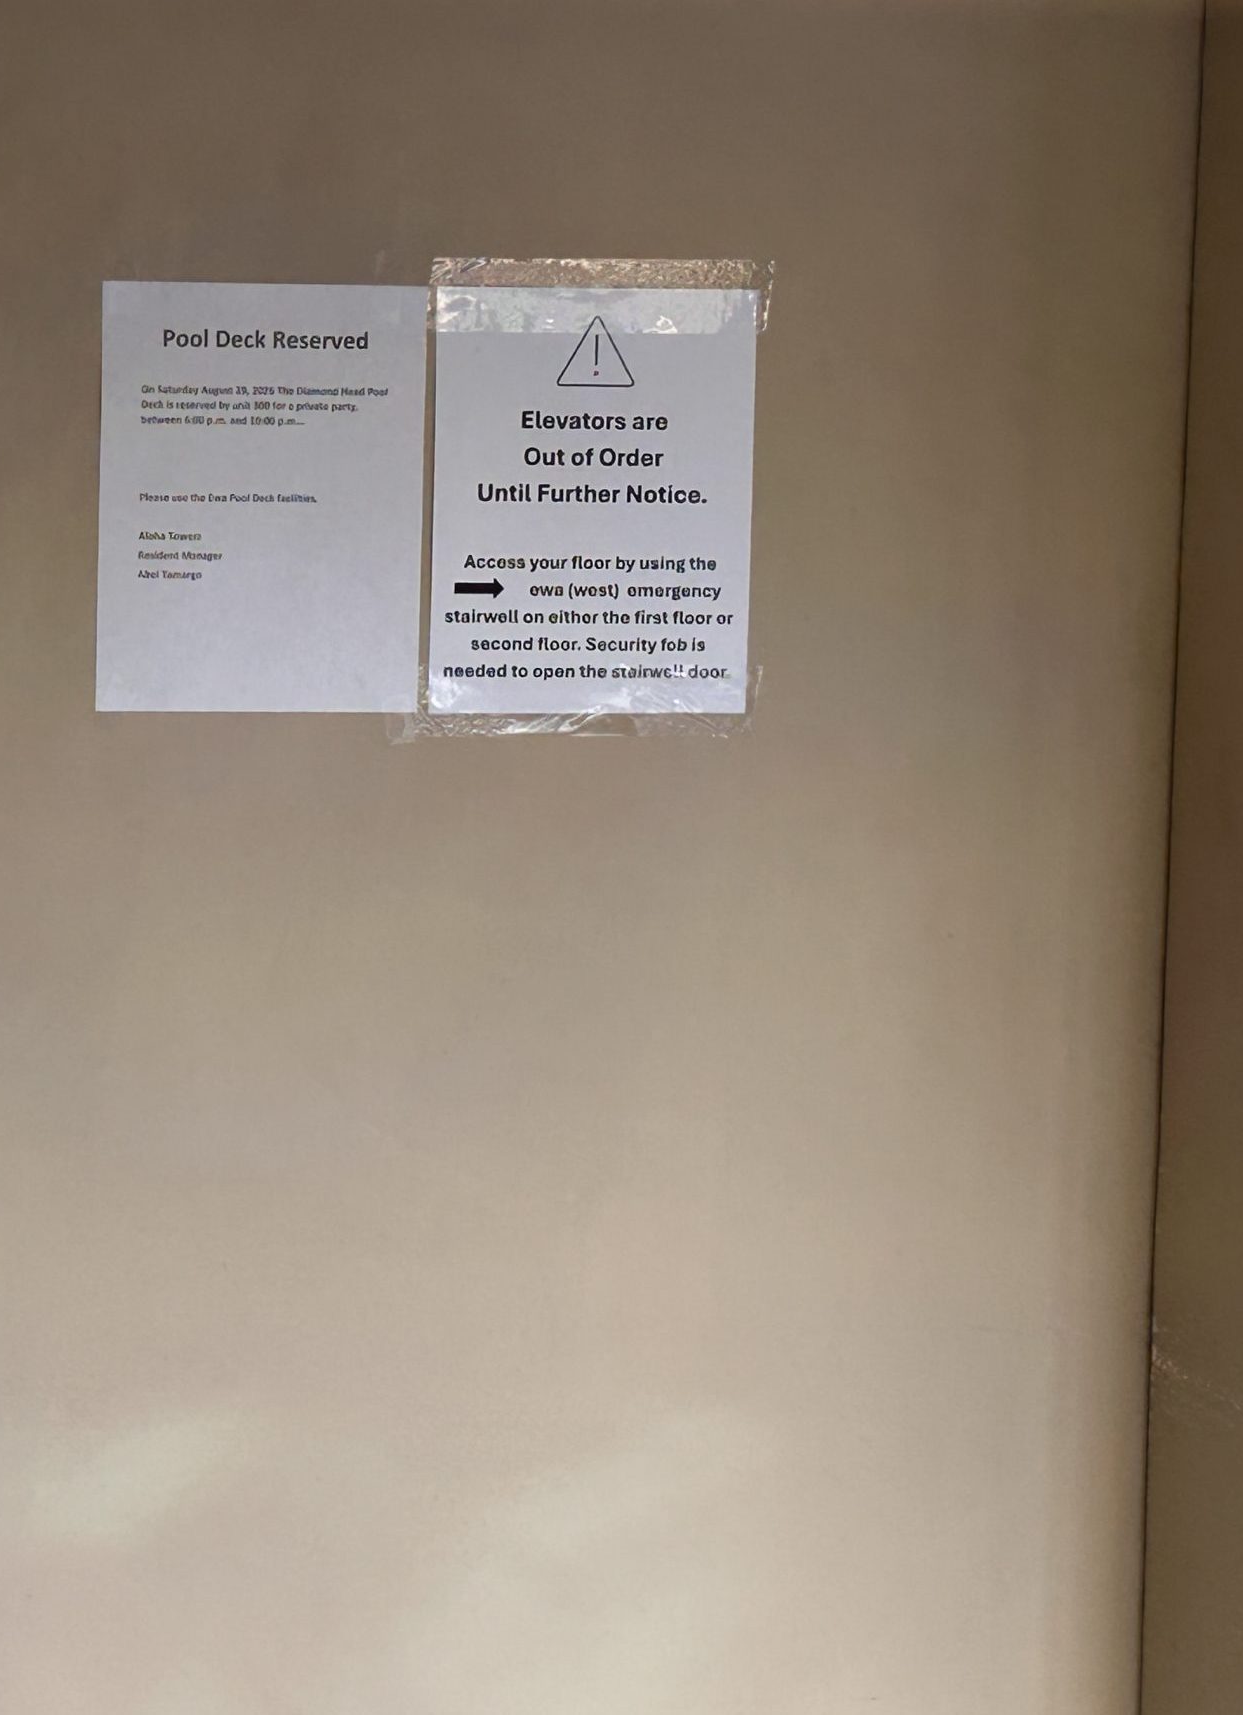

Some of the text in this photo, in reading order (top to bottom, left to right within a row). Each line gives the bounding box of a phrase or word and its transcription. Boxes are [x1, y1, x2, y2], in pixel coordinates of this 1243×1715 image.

[163, 329, 369, 350] Pool Deck Reserved
[141, 384, 155, 394] On
[158, 385, 199, 396] Saturday
[201, 386, 233, 397] August
[277, 386, 294, 396] The
[296, 387, 339, 397] Diamond
[341, 387, 365, 396] Head
[368, 388, 389, 397] Pool
[141, 400, 164, 409] Deck
[166, 400, 174, 409] is
[176, 401, 216, 410] reserved
[219, 401, 231, 411] by
[273, 401, 287, 410] for
[296, 402, 329, 412] private
[140, 416, 182, 425] between
[230, 416, 247, 425] and
[521, 410, 669, 431] Elevators are
[524, 447, 665, 467] Out of Order
[139, 493, 170, 503] Please
[172, 495, 188, 503] use
[190, 494, 206, 503] the
[230, 494, 250, 503] Pool
[252, 494, 275, 503] Deck
[478, 483, 708, 504] Until Further Notice.
[138, 531, 202, 541] Aloha Towers
[138, 551, 223, 562] Resident Manager
[464, 554, 717, 574] Access your floor by using the
[568, 582, 620, 601] (west)
[627, 585, 722, 602] emergency
[445, 609, 734, 626] stairwell on either the first floor or
[471, 636, 706, 655] second floor. Security fob is
[443, 664, 508, 679] needed
[511, 665, 529, 679] to
[533, 666, 576, 681] open
[579, 665, 608, 679] the
[611, 664, 685, 680] stairwell
